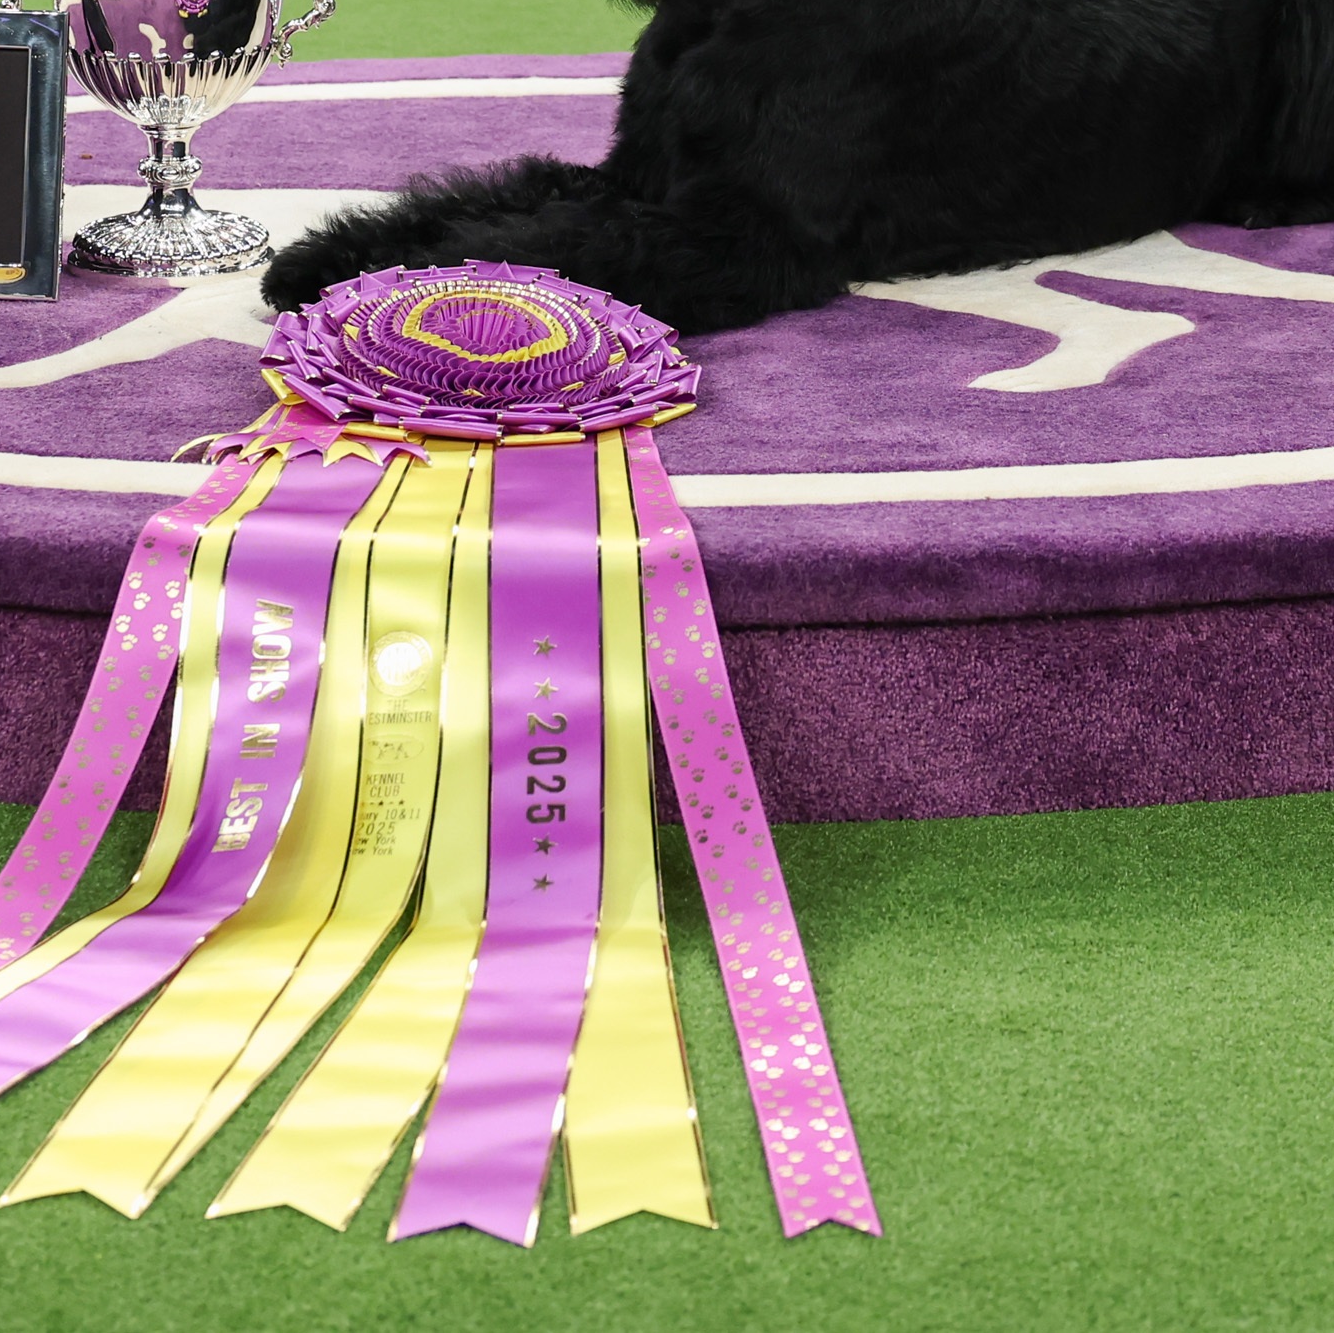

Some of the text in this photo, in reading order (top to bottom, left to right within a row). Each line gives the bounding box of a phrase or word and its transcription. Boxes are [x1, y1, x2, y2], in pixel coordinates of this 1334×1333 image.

[386, 698, 409, 712] THE
[366, 710, 433, 726] ESTMINSTER
[211, 598, 294, 853] BEST IN SHOW
[526, 712, 568, 824] 2025
[366, 772, 406, 785] KENNEL
[369, 785, 401, 798] CLUB
[356, 821, 396, 836] 2025
[375, 833, 397, 845] York
[372, 846, 394, 856] York
